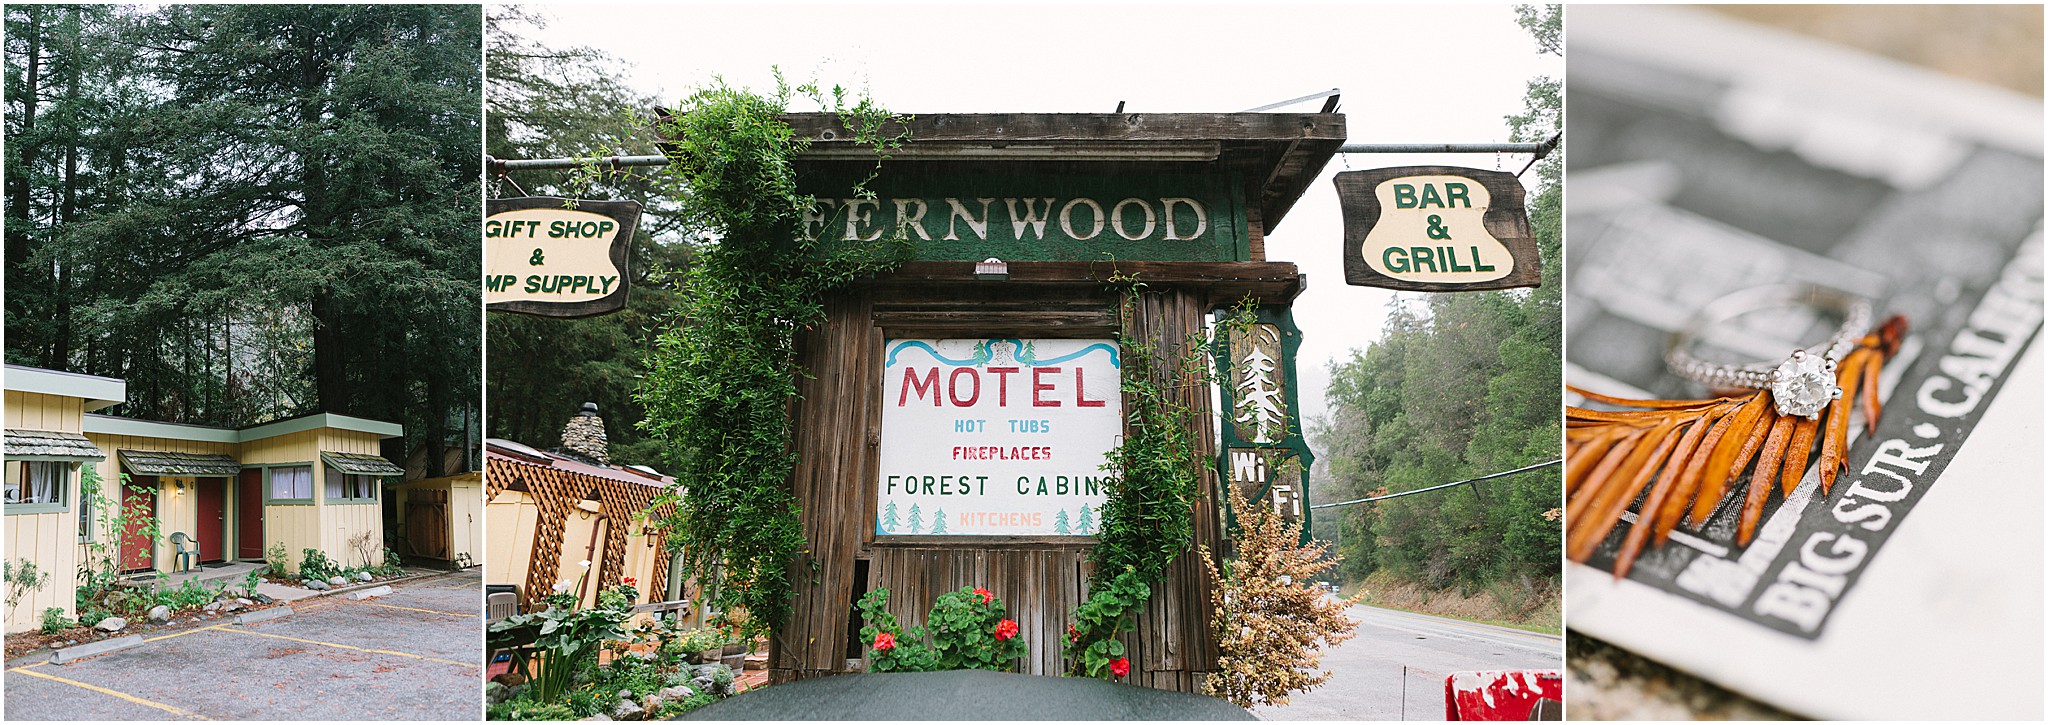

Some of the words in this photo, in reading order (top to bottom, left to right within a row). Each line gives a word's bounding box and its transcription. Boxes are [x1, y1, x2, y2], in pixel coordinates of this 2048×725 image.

[1393, 183, 1472, 209] BAR
[486, 220, 541, 238] GIFT
[548, 220, 614, 239] SHOP
[793, 197, 1208, 241] FERNWOOD
[1426, 214, 1452, 240] &
[529, 248, 545, 266] &
[1382, 246, 1496, 273] GRILL
[524, 275, 618, 295] SUPPLY
[897, 366, 1106, 408] MOTEL
[954, 419, 986, 433] HOT
[1008, 419, 1050, 433] TUBS
[952, 446, 1051, 461] FIREPLACES
[1232, 452, 1265, 483] Wi
[887, 475, 989, 496] FOREST
[1272, 485, 1300, 516] Fi
[960, 512, 1042, 527] KITCHENS
[1753, 530, 1869, 633] BIG
[1832, 438, 1944, 532] SUR
